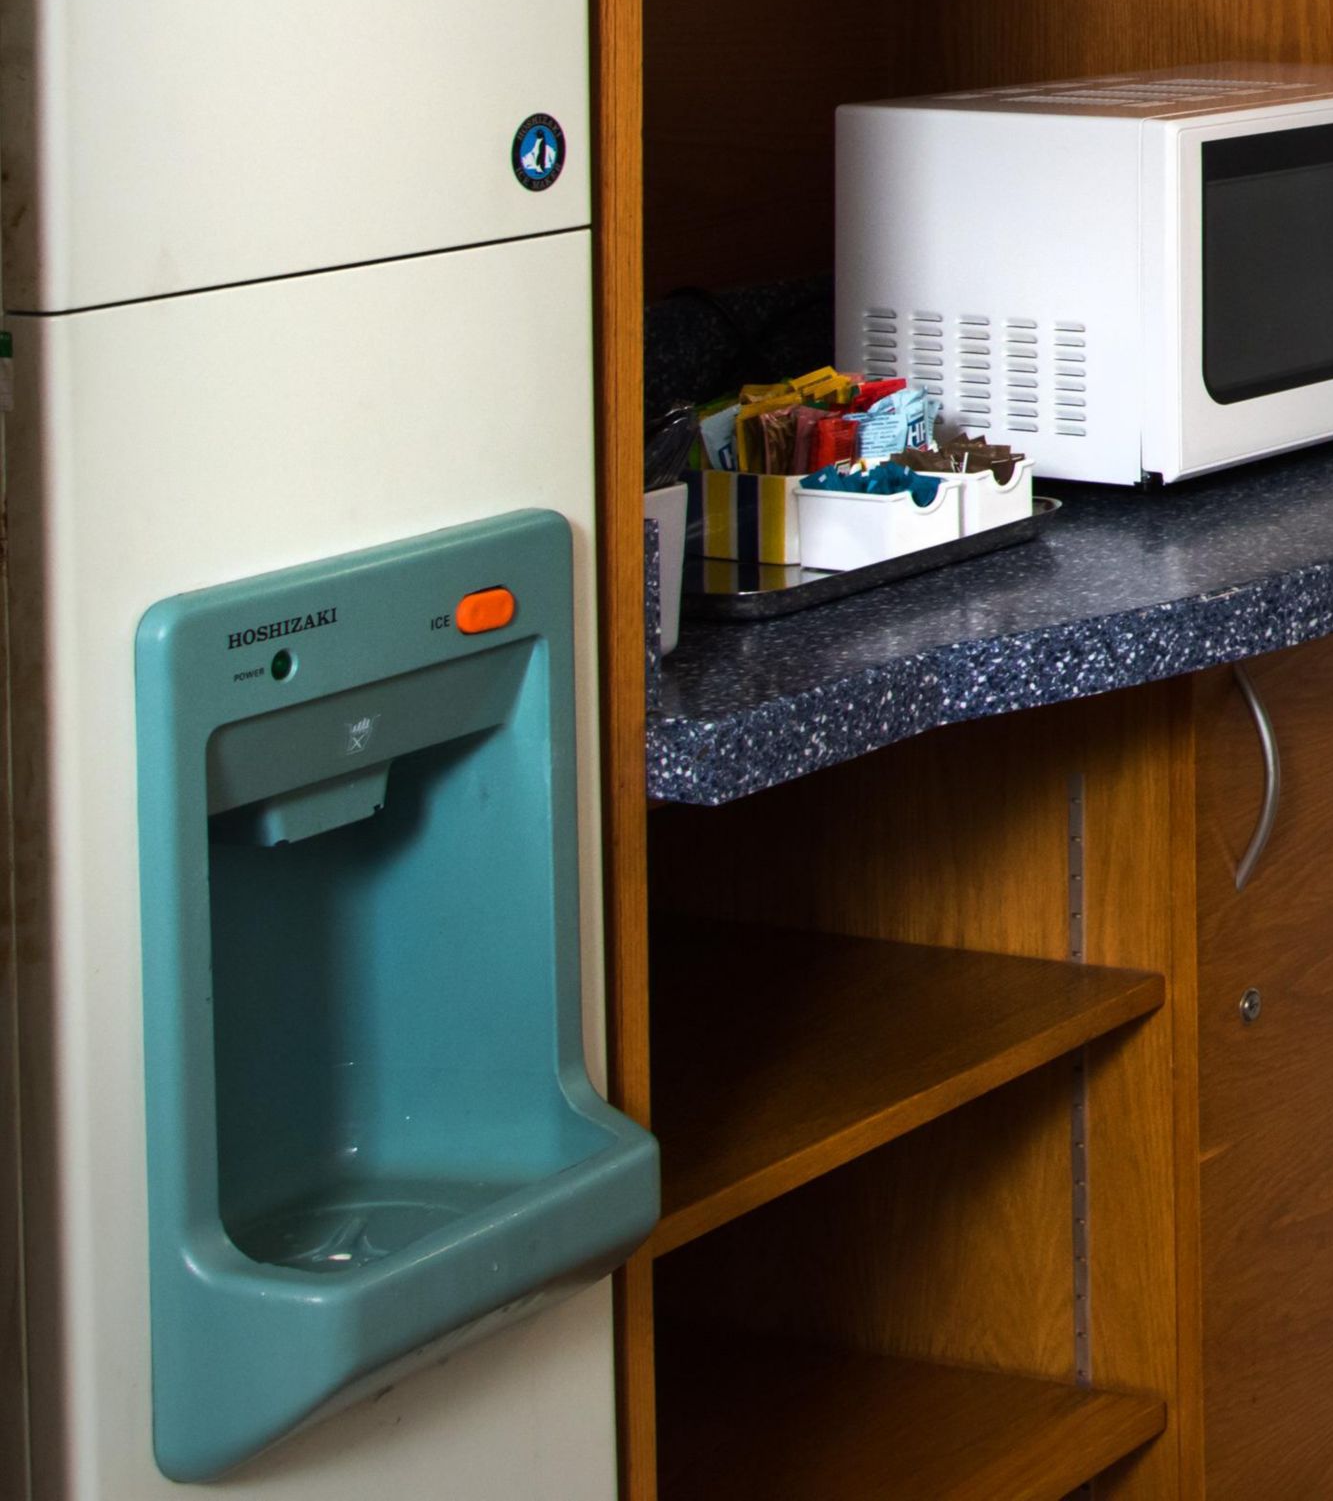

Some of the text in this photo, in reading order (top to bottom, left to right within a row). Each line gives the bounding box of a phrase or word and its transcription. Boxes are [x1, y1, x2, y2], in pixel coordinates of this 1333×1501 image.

[227, 607, 338, 651] HOSHIZAKI
[431, 614, 451, 631] ICE
[233, 666, 265, 683] POWER
